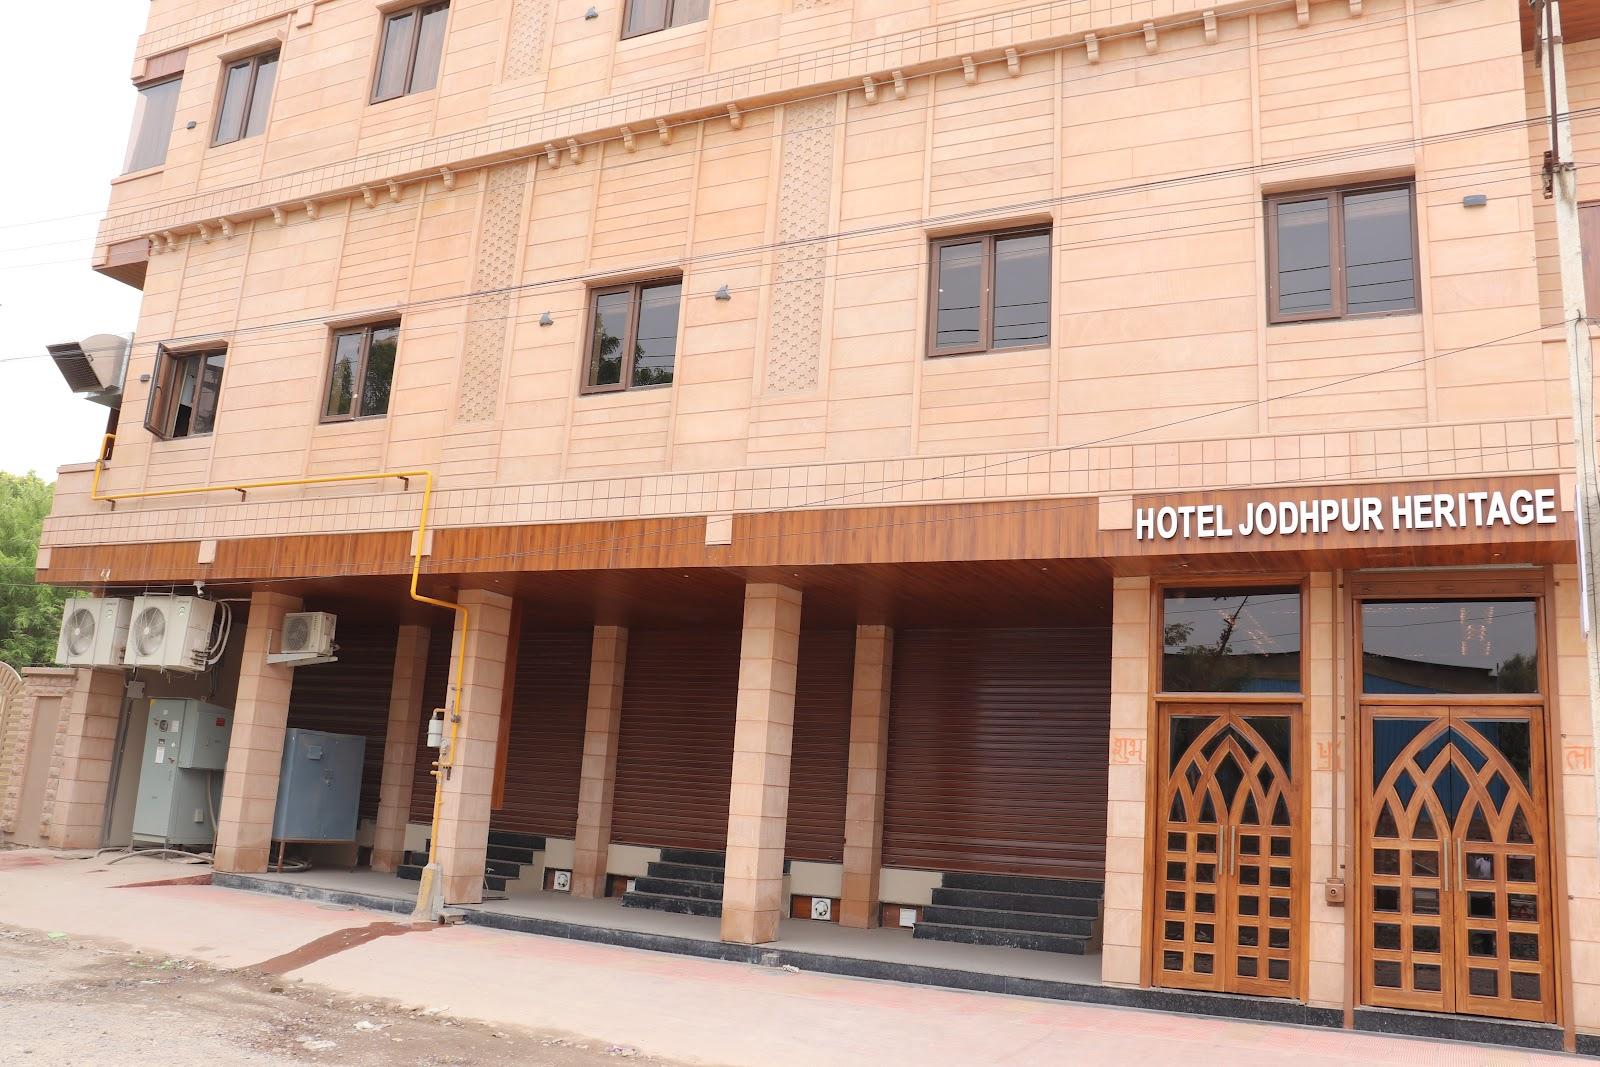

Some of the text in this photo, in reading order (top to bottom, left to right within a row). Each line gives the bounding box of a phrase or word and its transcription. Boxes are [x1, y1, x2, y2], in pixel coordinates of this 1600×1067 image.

[1136, 488, 1557, 540] HOTEL JODHPUR HERITAGE
[1563, 745, 1593, 770] ला
